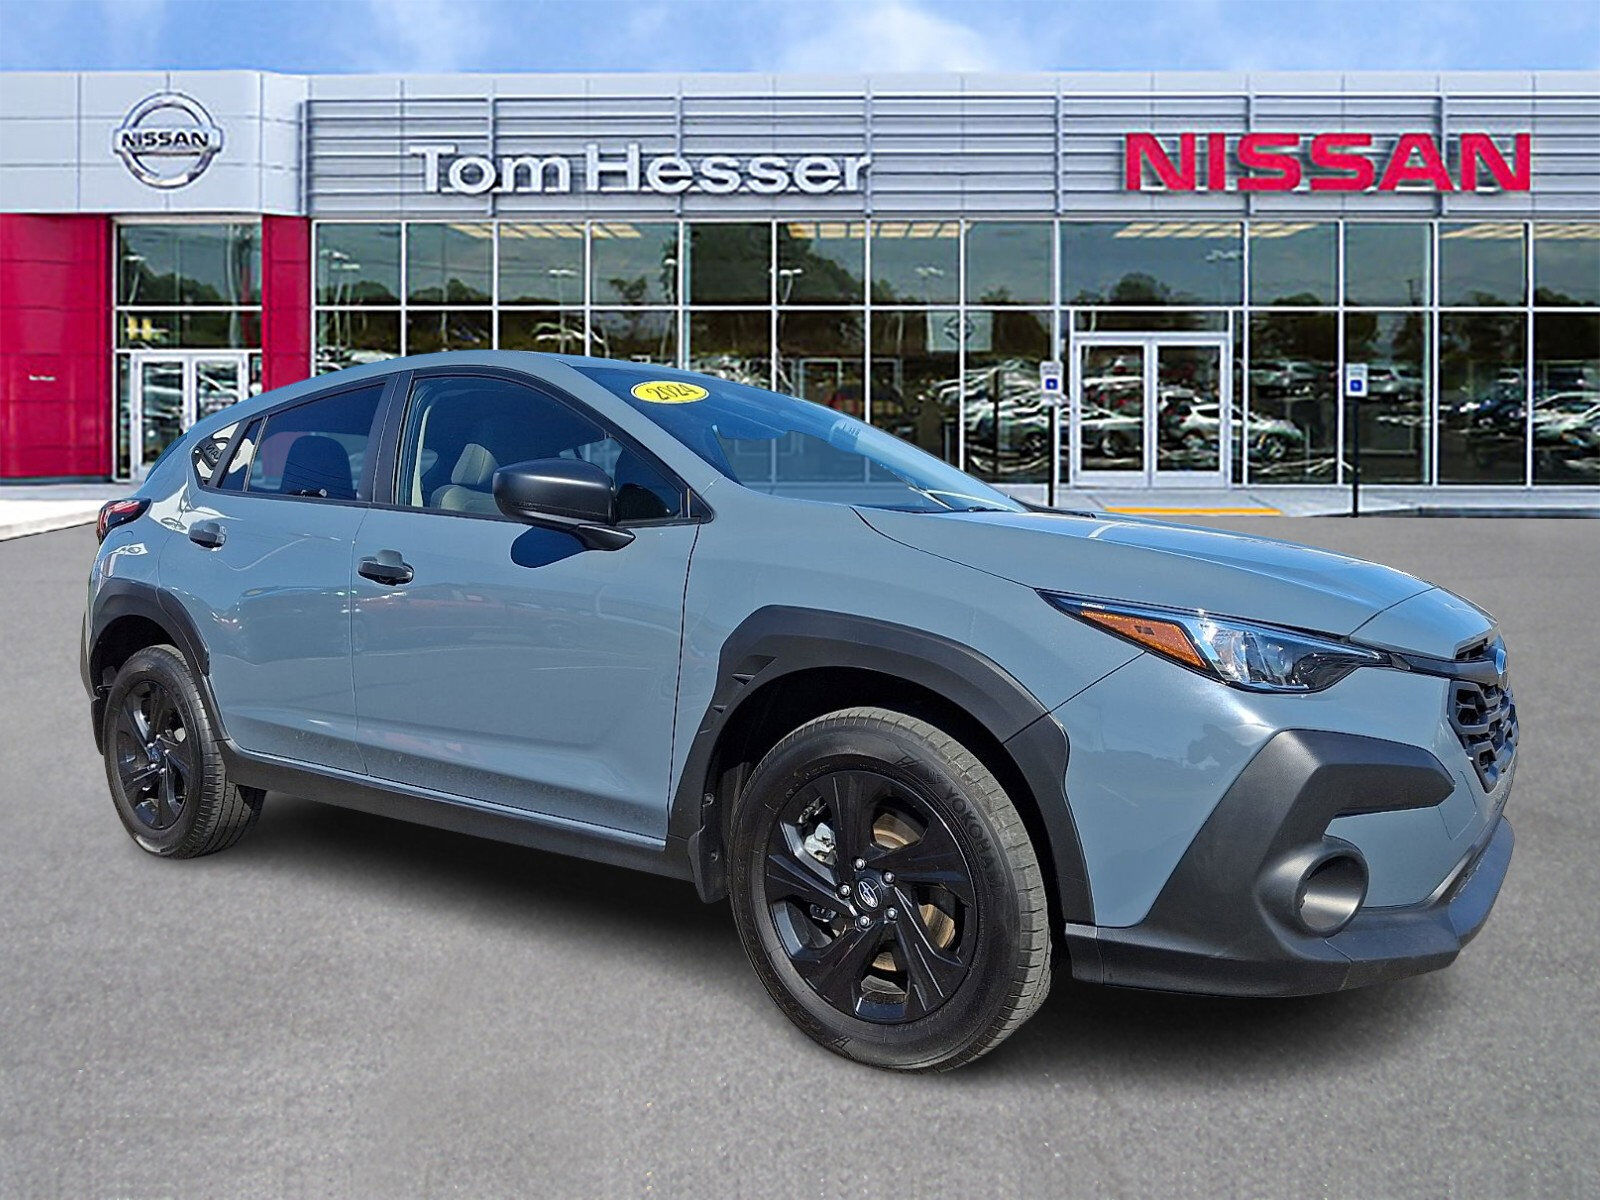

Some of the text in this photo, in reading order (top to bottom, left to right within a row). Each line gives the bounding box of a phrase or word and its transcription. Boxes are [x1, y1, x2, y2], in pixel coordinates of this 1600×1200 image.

[121, 131, 209, 147] NISSAN
[409, 143, 871, 194] Tom Hesser
[1125, 132, 1530, 191] NISSAN
[646, 384, 699, 401] 2024
